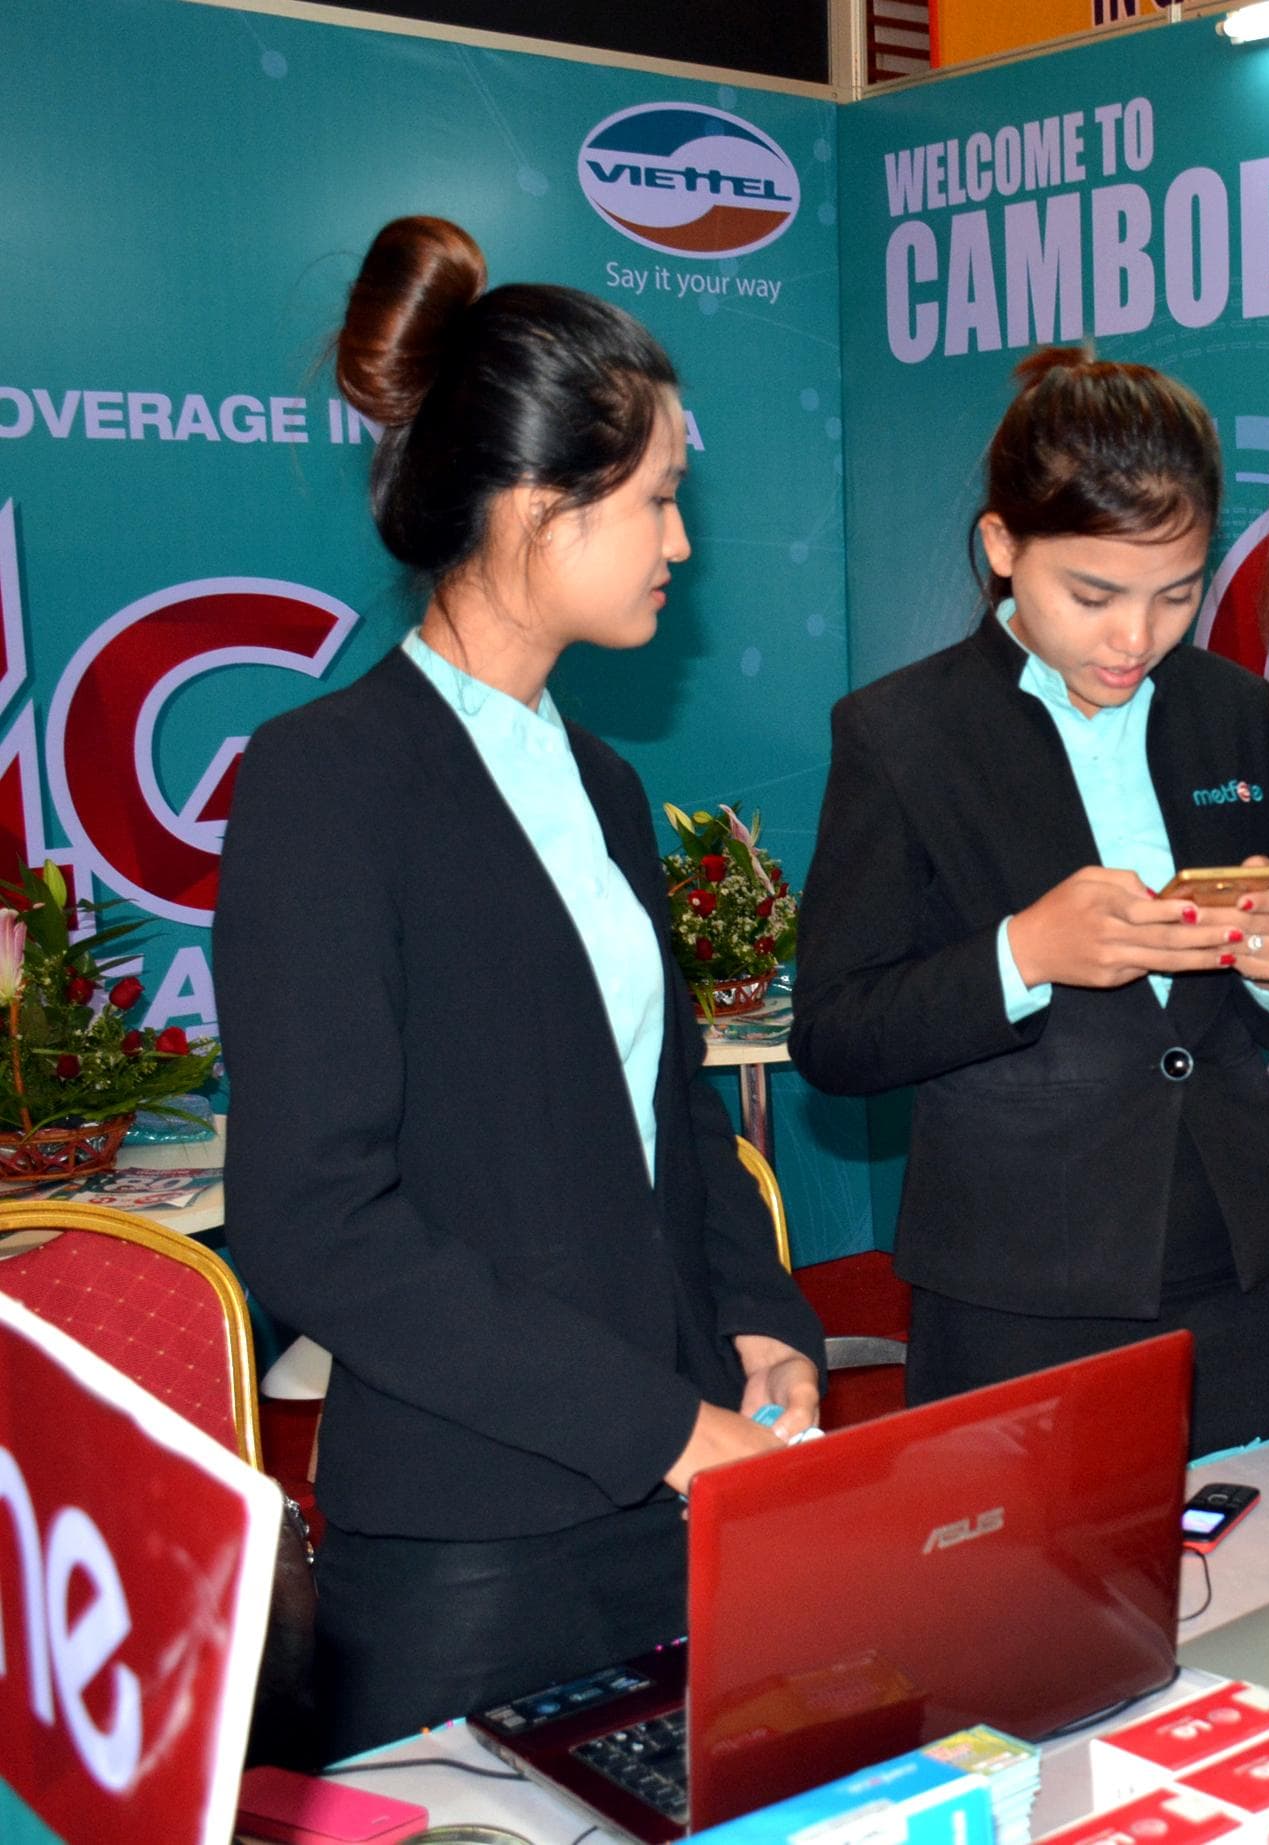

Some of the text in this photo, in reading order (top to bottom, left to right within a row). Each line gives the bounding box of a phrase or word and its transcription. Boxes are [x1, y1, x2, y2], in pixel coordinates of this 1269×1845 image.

[884, 97, 1154, 217] WELCOME TO
[606, 261, 781, 304] Say it your way
[922, 1505, 1005, 1554] ASUS
[1171, 1718, 1213, 1739] LG
